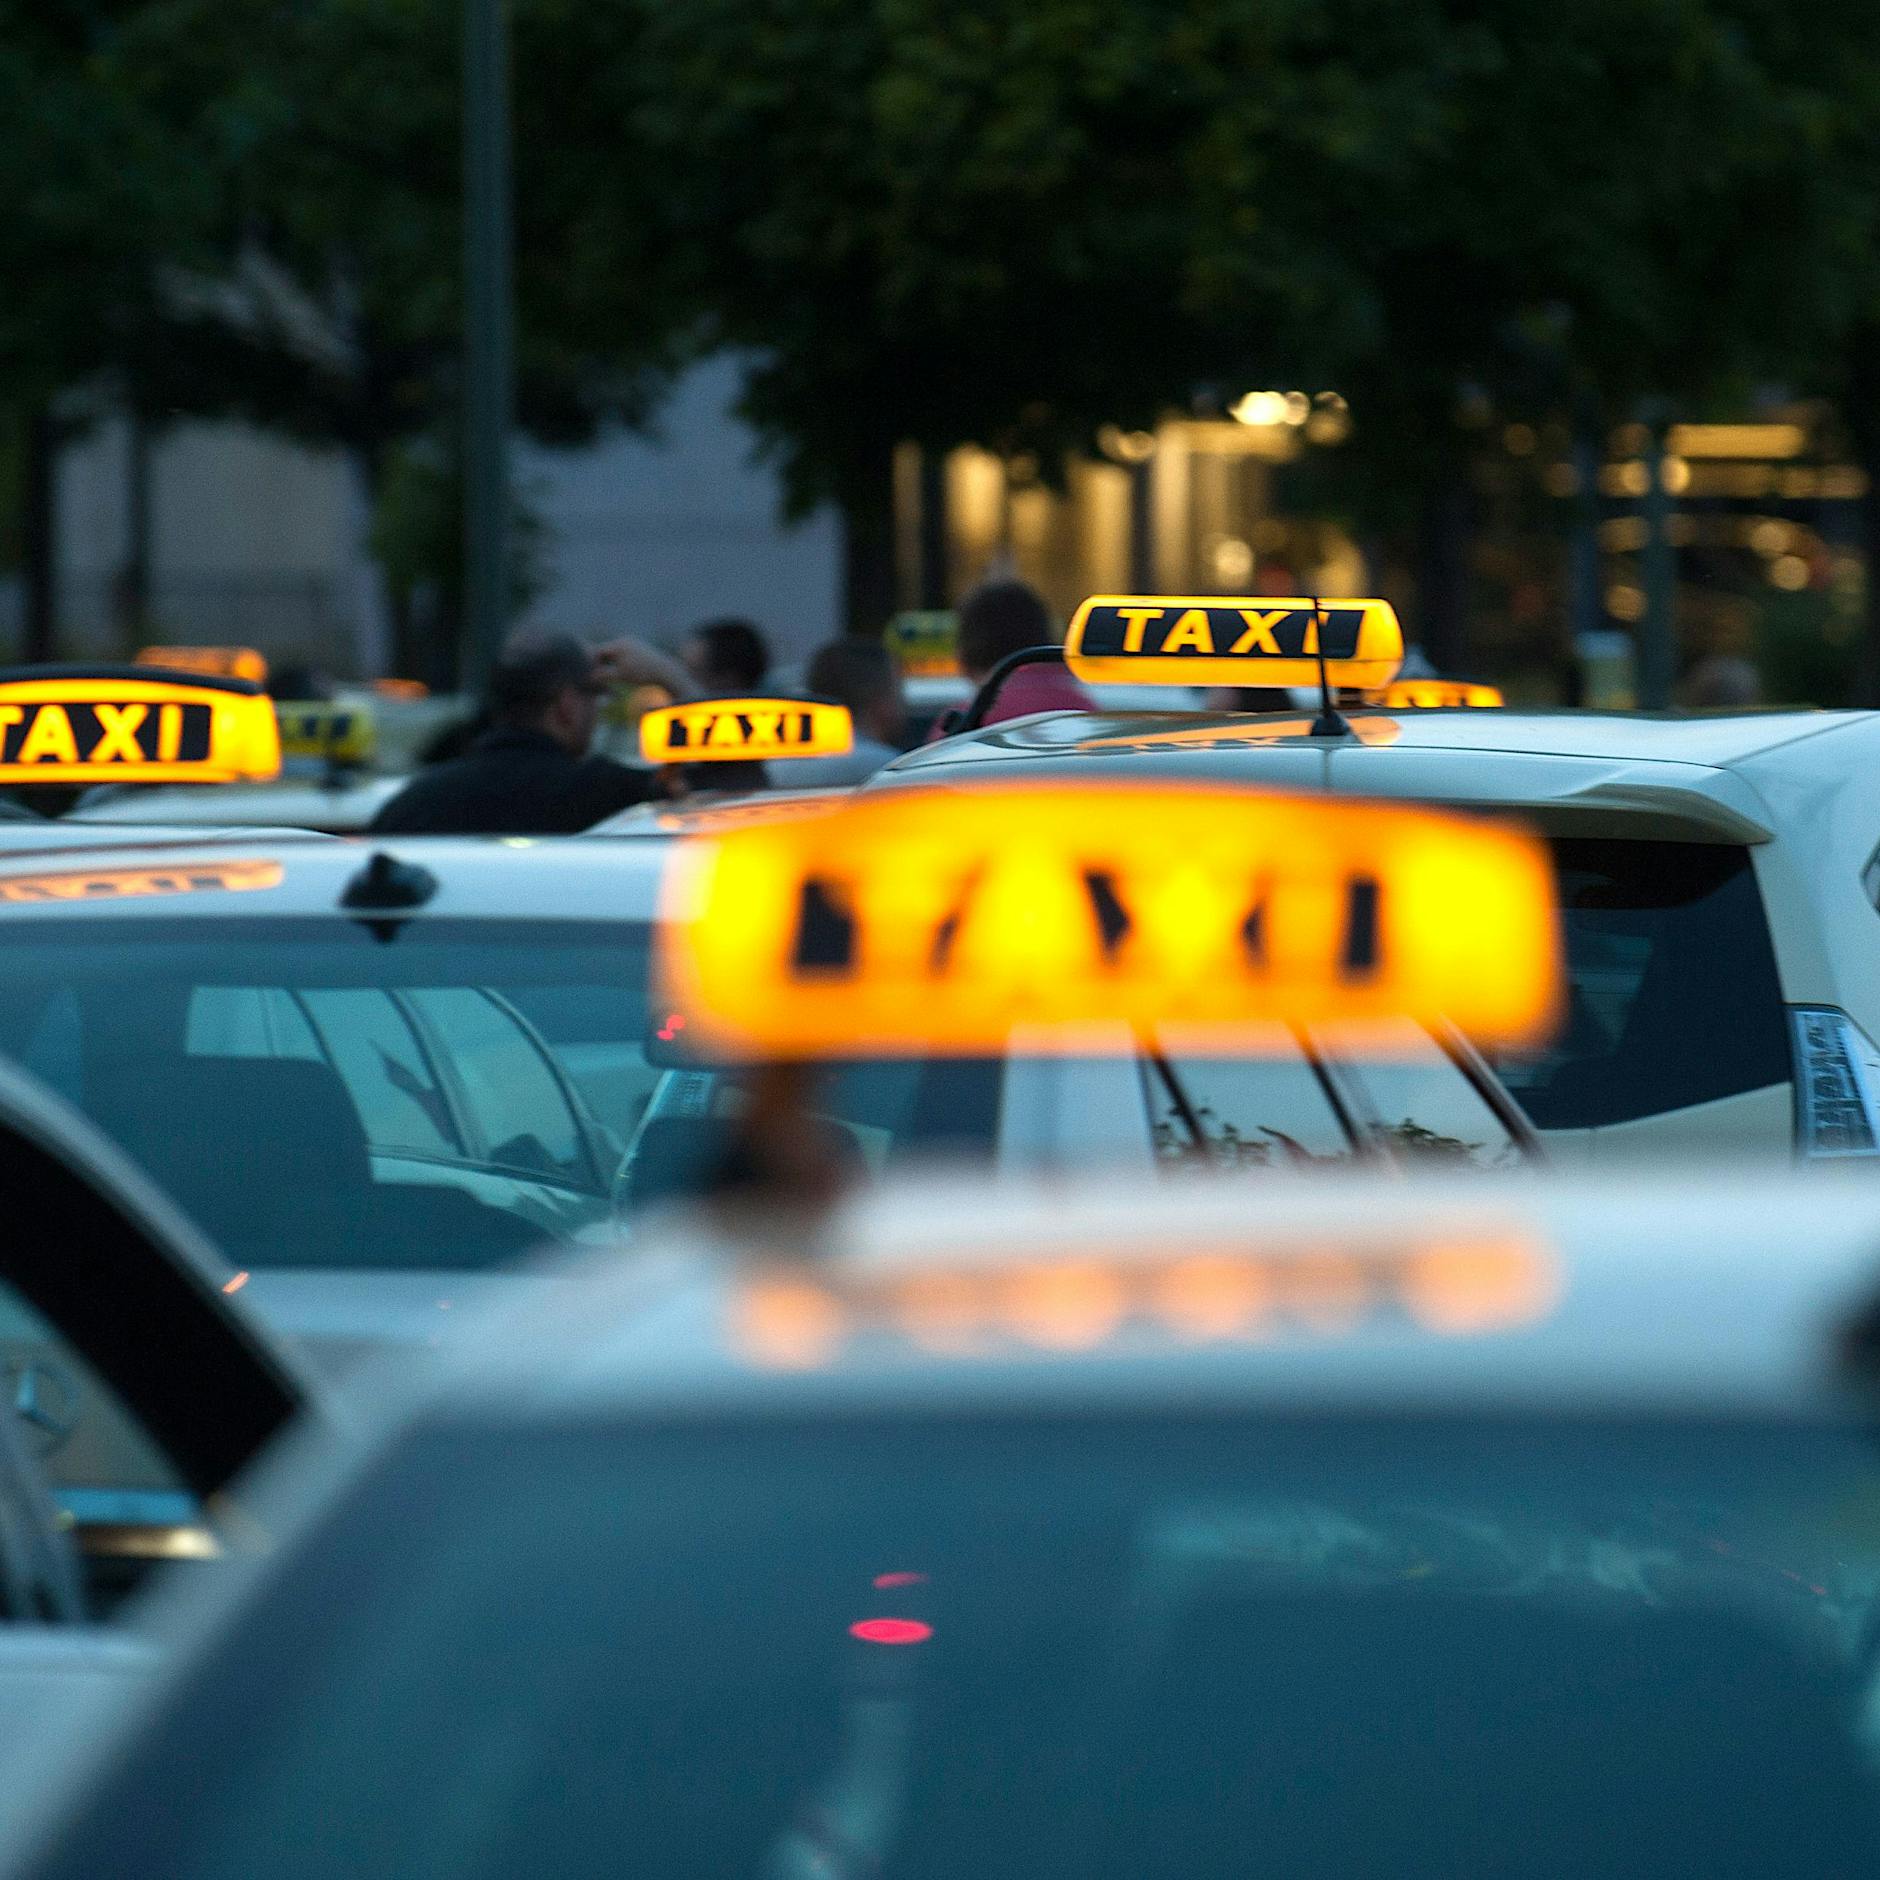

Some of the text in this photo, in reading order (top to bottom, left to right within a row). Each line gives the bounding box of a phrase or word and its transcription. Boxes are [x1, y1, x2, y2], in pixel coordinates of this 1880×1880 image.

[1116, 608, 1330, 655] TAXI
[679, 713, 803, 747] TAXI
[822, 865, 1348, 982] TAXI
